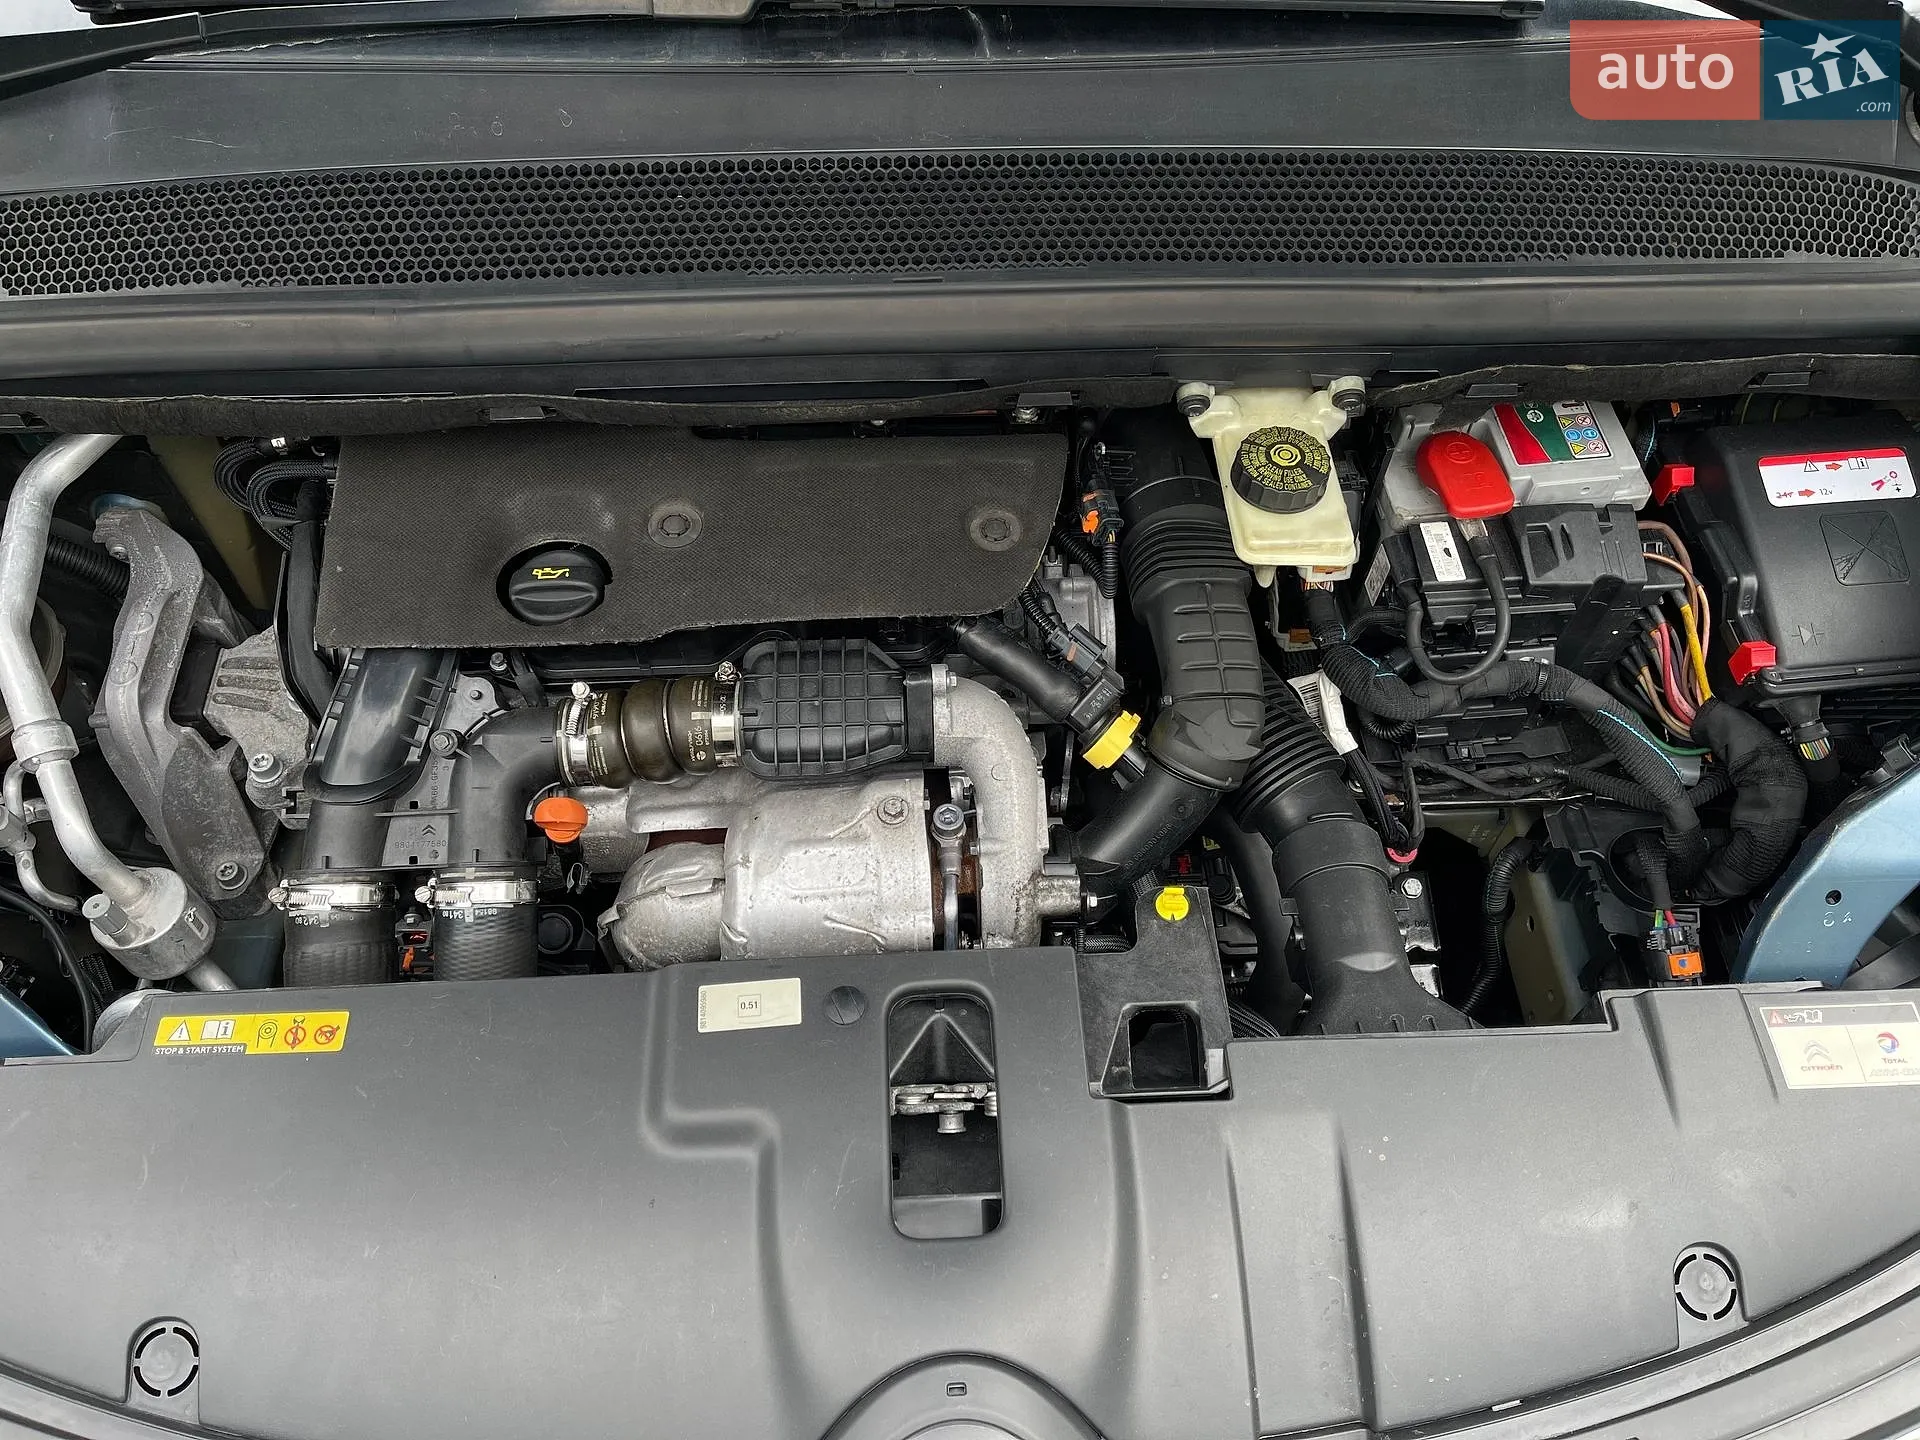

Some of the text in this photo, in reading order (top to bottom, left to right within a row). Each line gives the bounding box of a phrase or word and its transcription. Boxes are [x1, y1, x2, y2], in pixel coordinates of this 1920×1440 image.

[740, 1001, 758, 1010] 0.51
[155, 1047, 177, 1055] STOP
[186, 1046, 212, 1054] START
[212, 1045, 244, 1053] SYSTEM
